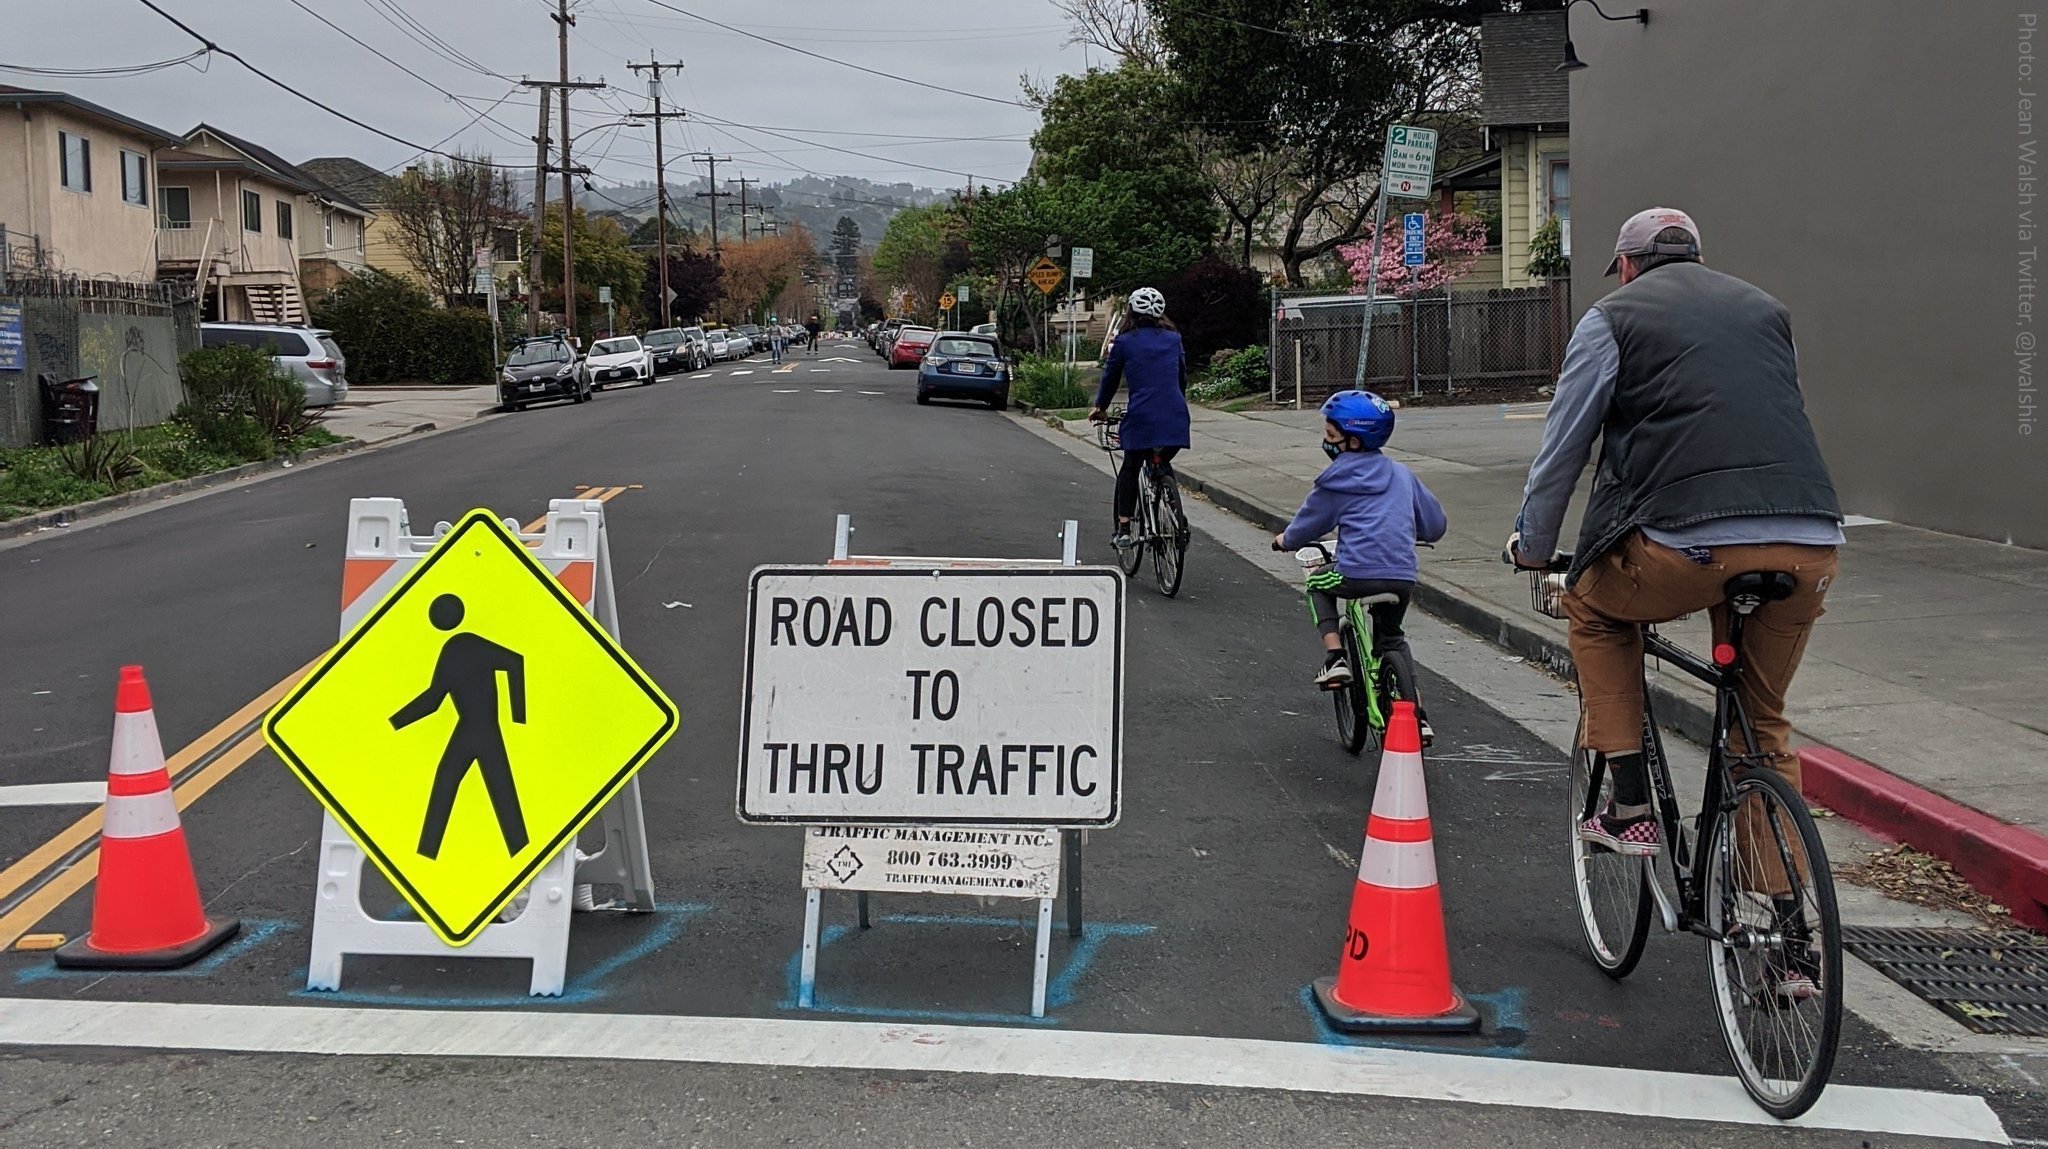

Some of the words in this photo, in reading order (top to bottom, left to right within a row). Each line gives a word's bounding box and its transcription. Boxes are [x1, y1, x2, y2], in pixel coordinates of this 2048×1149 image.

[1394, 128, 1405, 143] 2
[1413, 131, 1430, 140] HOUR
[1407, 139, 1433, 149] PARKING
[1391, 161, 1406, 169] MON
[1402, 182, 1410, 190] N
[943, 297, 953, 305] 15
[770, 596, 892, 647] ROAD
[920, 596, 1100, 647] CLOSED
[906, 669, 960, 721] TO
[763, 743, 884, 795] THRU
[910, 744, 1098, 797] TRAFFIC
[819, 825, 891, 840] TRAFFIC
[894, 828, 1011, 845] MANAGEMENT
[886, 849, 921, 866] 800
[926, 851, 1013, 870] 763.3999
